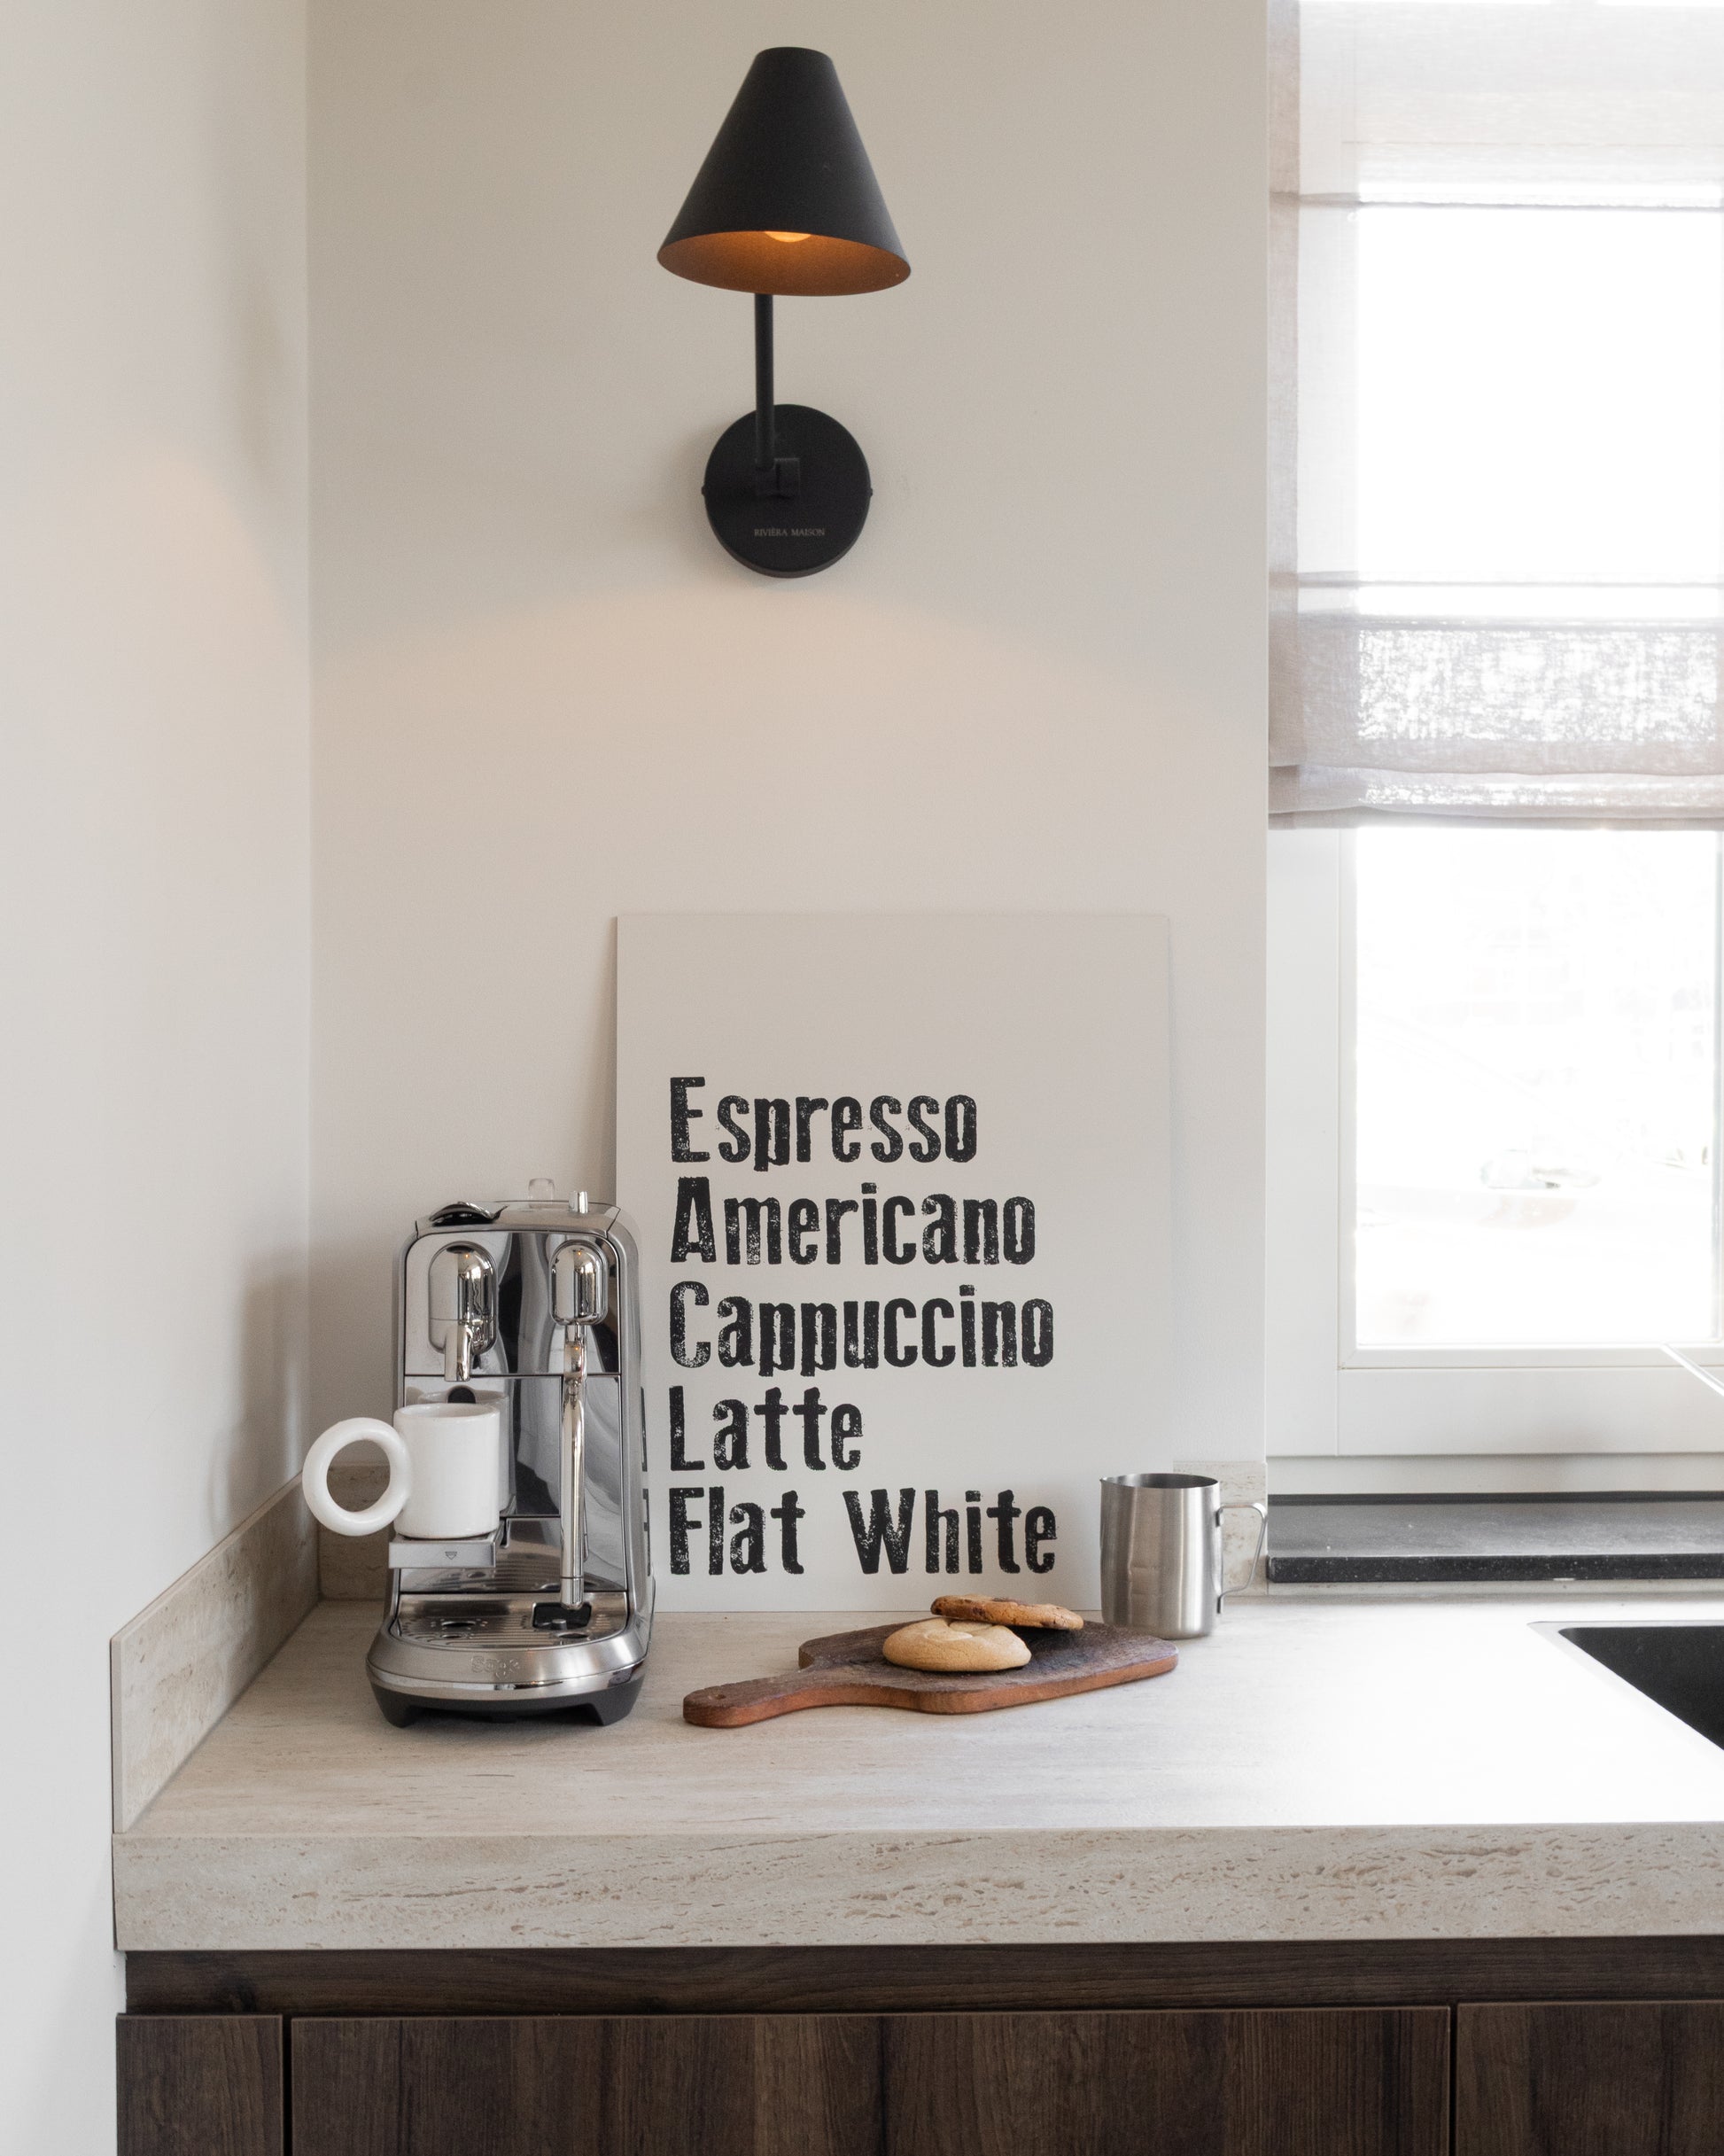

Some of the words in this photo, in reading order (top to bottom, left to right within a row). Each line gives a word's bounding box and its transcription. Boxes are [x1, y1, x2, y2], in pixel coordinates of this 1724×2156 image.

[791, 527, 826, 537] MAISON
[670, 1076, 978, 1172] Espresso
[670, 1176, 1036, 1265] Americano
[669, 1280, 1054, 1377] Cappuccino
[669, 1385, 863, 1472] Latte
[669, 1486, 805, 1576] Flat
[843, 1487, 1057, 1575] White
